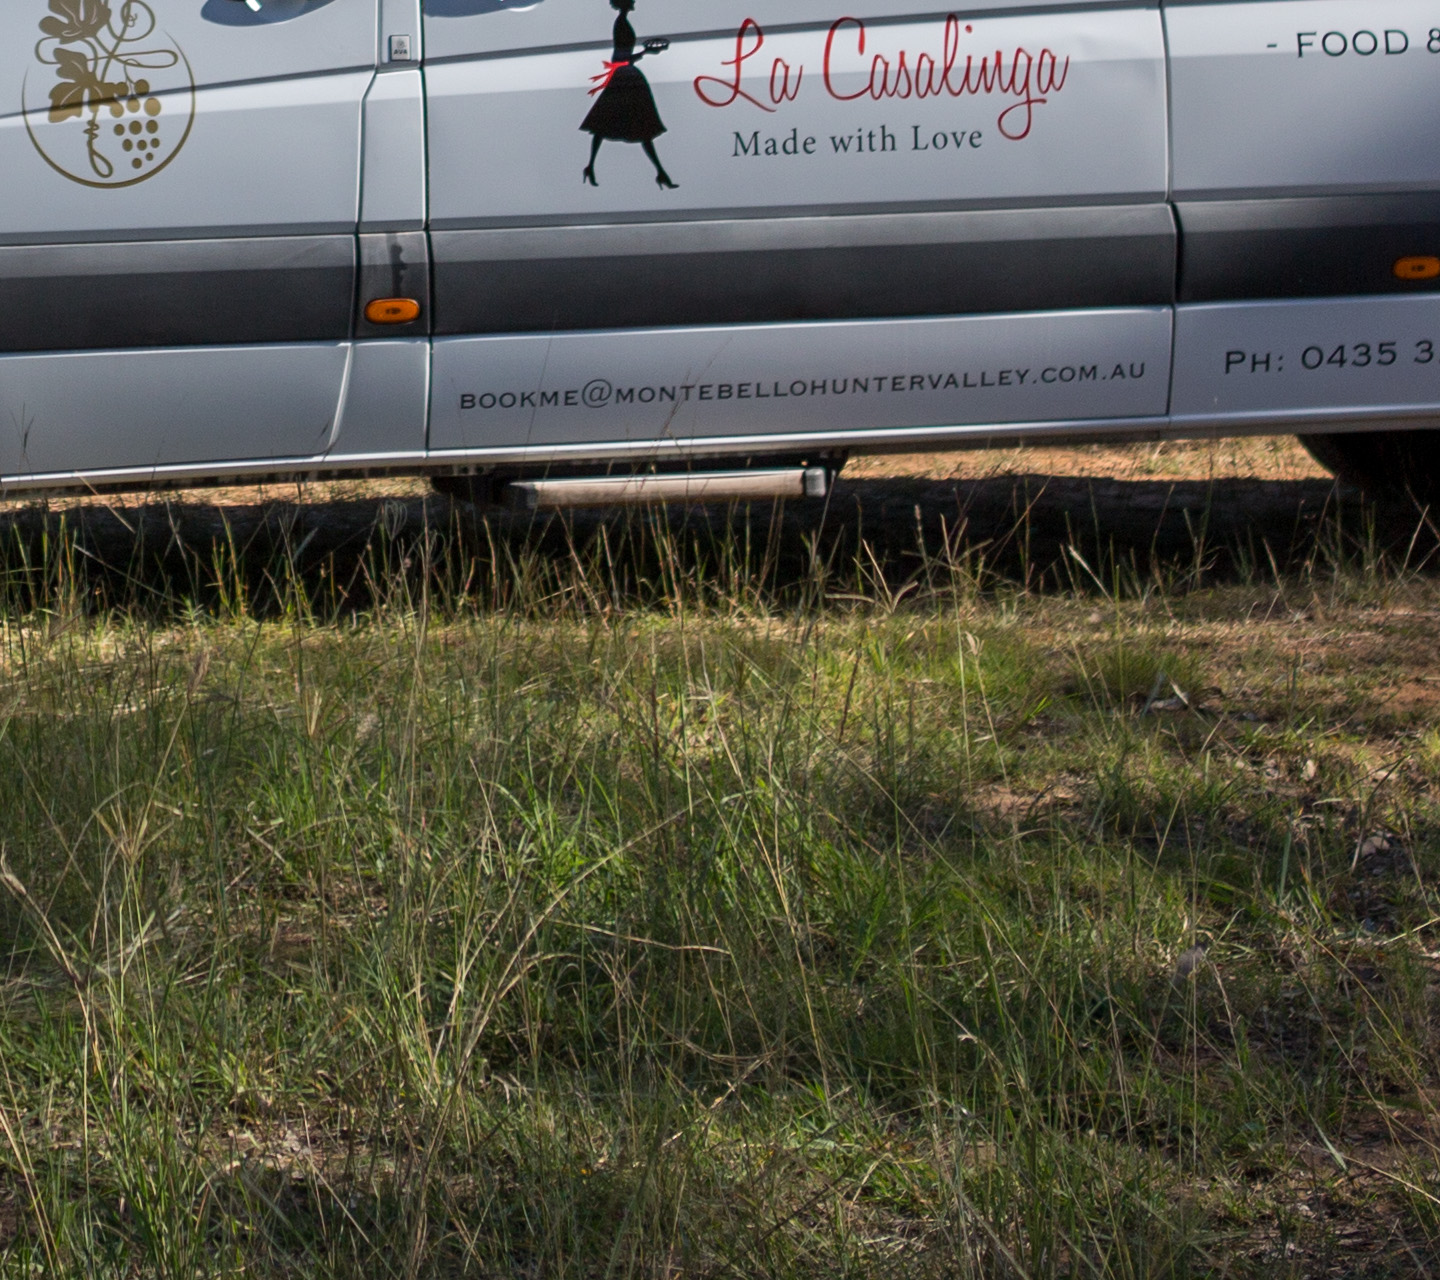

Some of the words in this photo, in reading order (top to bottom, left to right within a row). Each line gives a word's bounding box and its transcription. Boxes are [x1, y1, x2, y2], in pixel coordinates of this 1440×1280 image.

[1296, 29, 1409, 58] FOOD
[694, 17, 803, 113] La
[823, 13, 1070, 140] Casalinga
[731, 128, 817, 157] Made
[830, 126, 898, 154] with
[910, 125, 983, 151] Love
[1225, 351, 1284, 374] PH:
[1301, 342, 1398, 370] 0435
[460, 362, 1145, 409] BOOKME@MONTEBELLOHUNTERVALLEY.COM.AU
